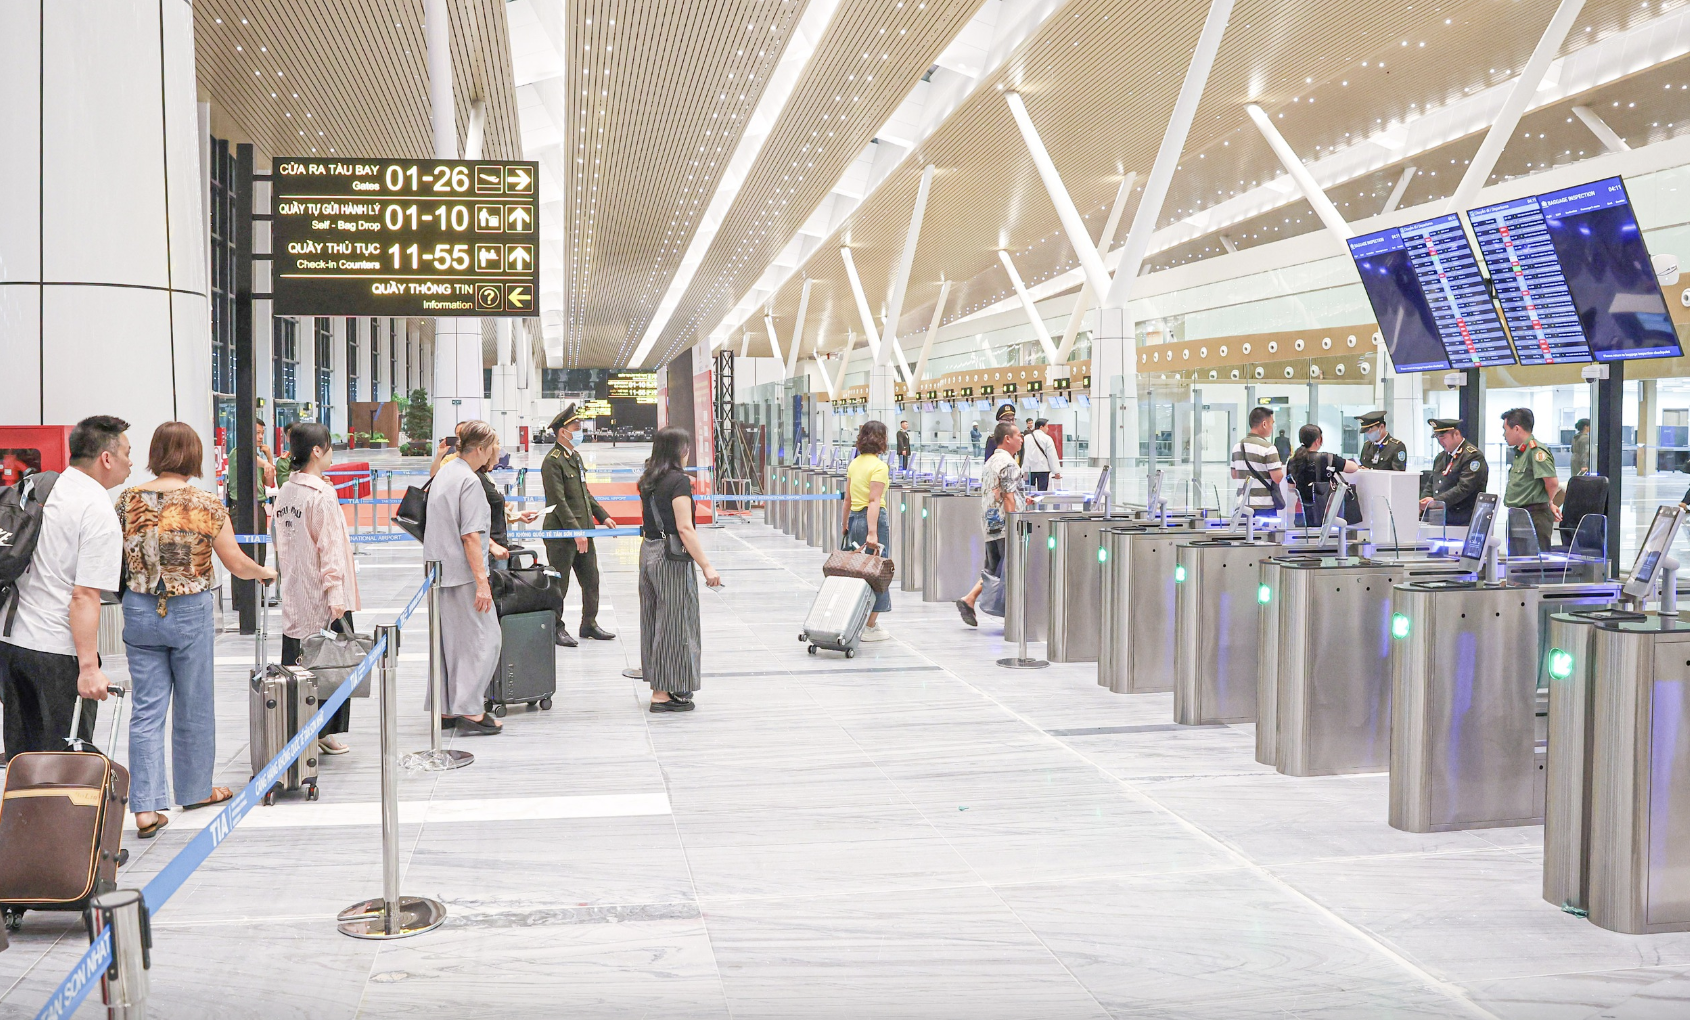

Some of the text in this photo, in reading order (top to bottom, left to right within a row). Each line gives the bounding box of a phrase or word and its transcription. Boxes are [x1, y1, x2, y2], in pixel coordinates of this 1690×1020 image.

[280, 162, 379, 175] CỬA RA TÀU BAY
[352, 181, 380, 190] Gates
[386, 165, 470, 192] 01-26
[279, 201, 380, 216] QUẦY TỰ GỬI HÀNH LÝ
[386, 205, 469, 231] 01-10
[312, 220, 330, 229] Self
[338, 221, 356, 231] Bag
[358, 221, 381, 232] Drop
[288, 240, 380, 256] QUẦY THỦ TỤC
[388, 243, 470, 270] 11-55
[297, 260, 380, 269] Check-in Counters
[372, 281, 473, 294] QUẦY THÔNG TIN
[423, 300, 473, 310] Information
[210, 812, 229, 847] TIA
